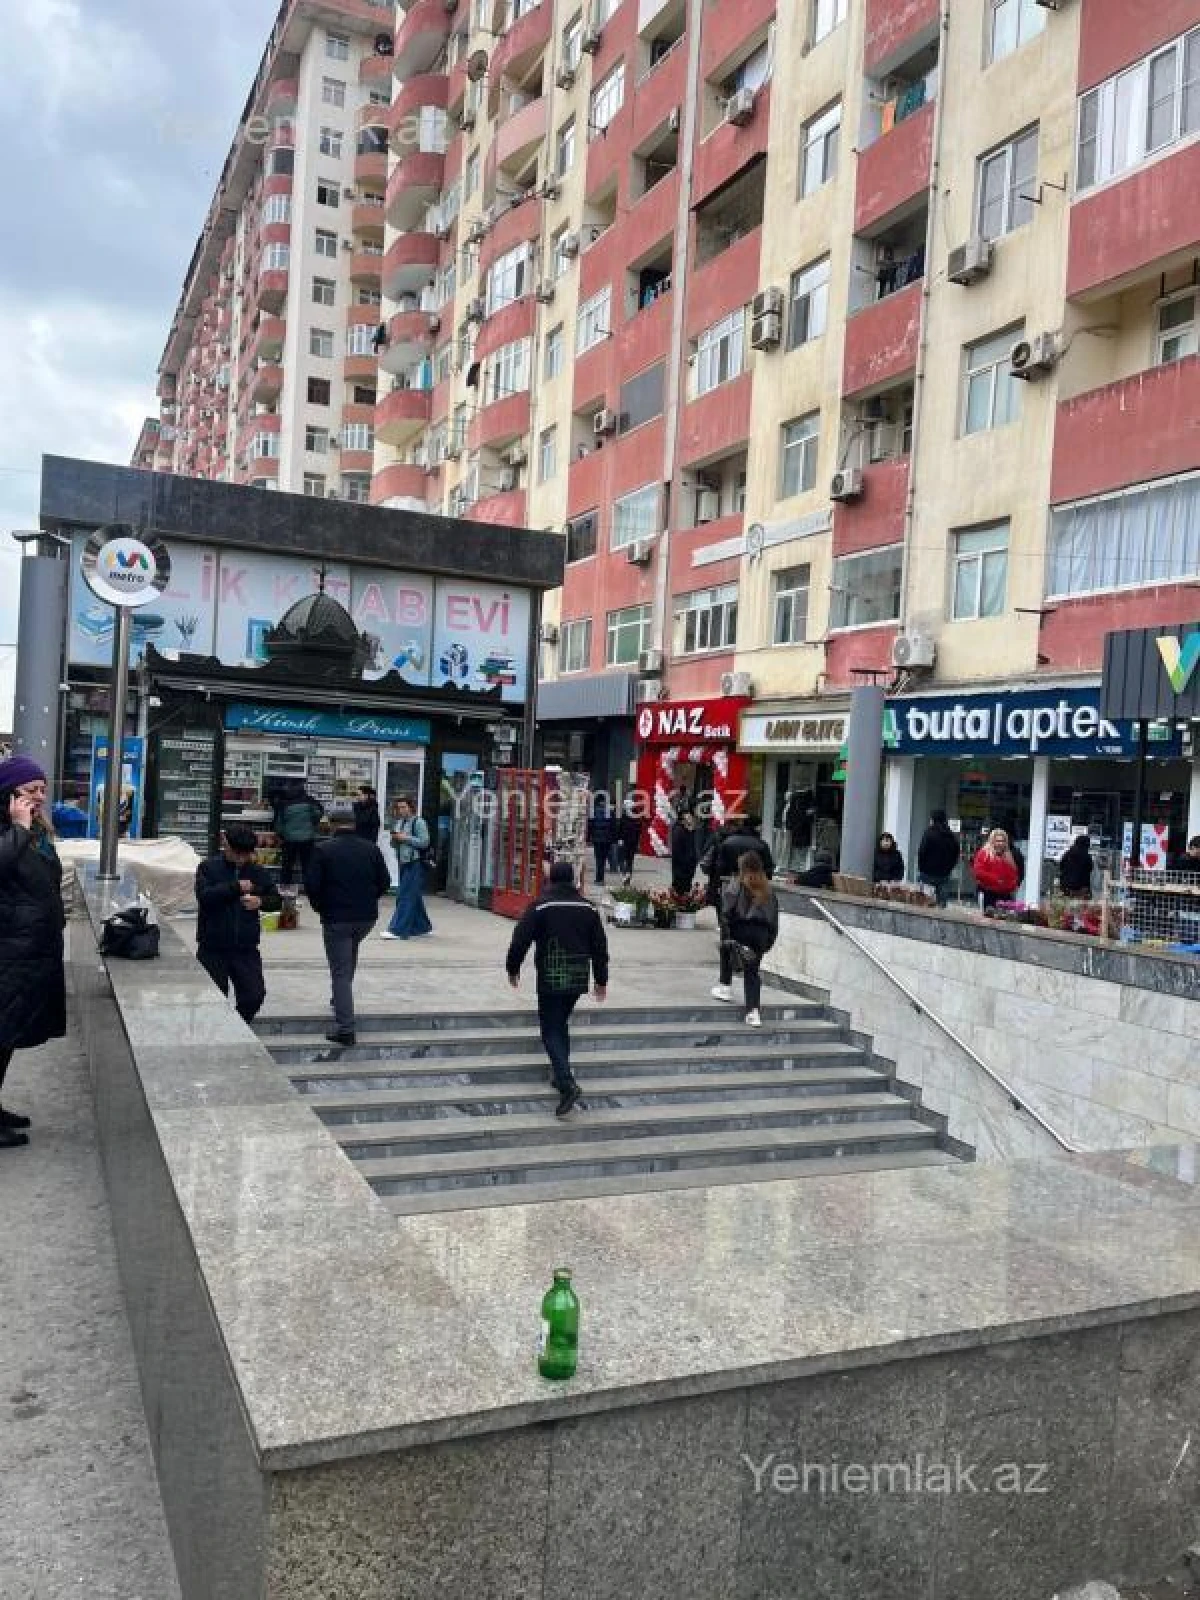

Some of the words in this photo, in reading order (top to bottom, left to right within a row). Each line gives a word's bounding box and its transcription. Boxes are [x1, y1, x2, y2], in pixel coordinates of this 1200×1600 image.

[109, 571, 145, 583] metro
[446, 592, 511, 636] EVİ
[657, 707, 705, 735] NAZ
[905, 705, 991, 741] buta
